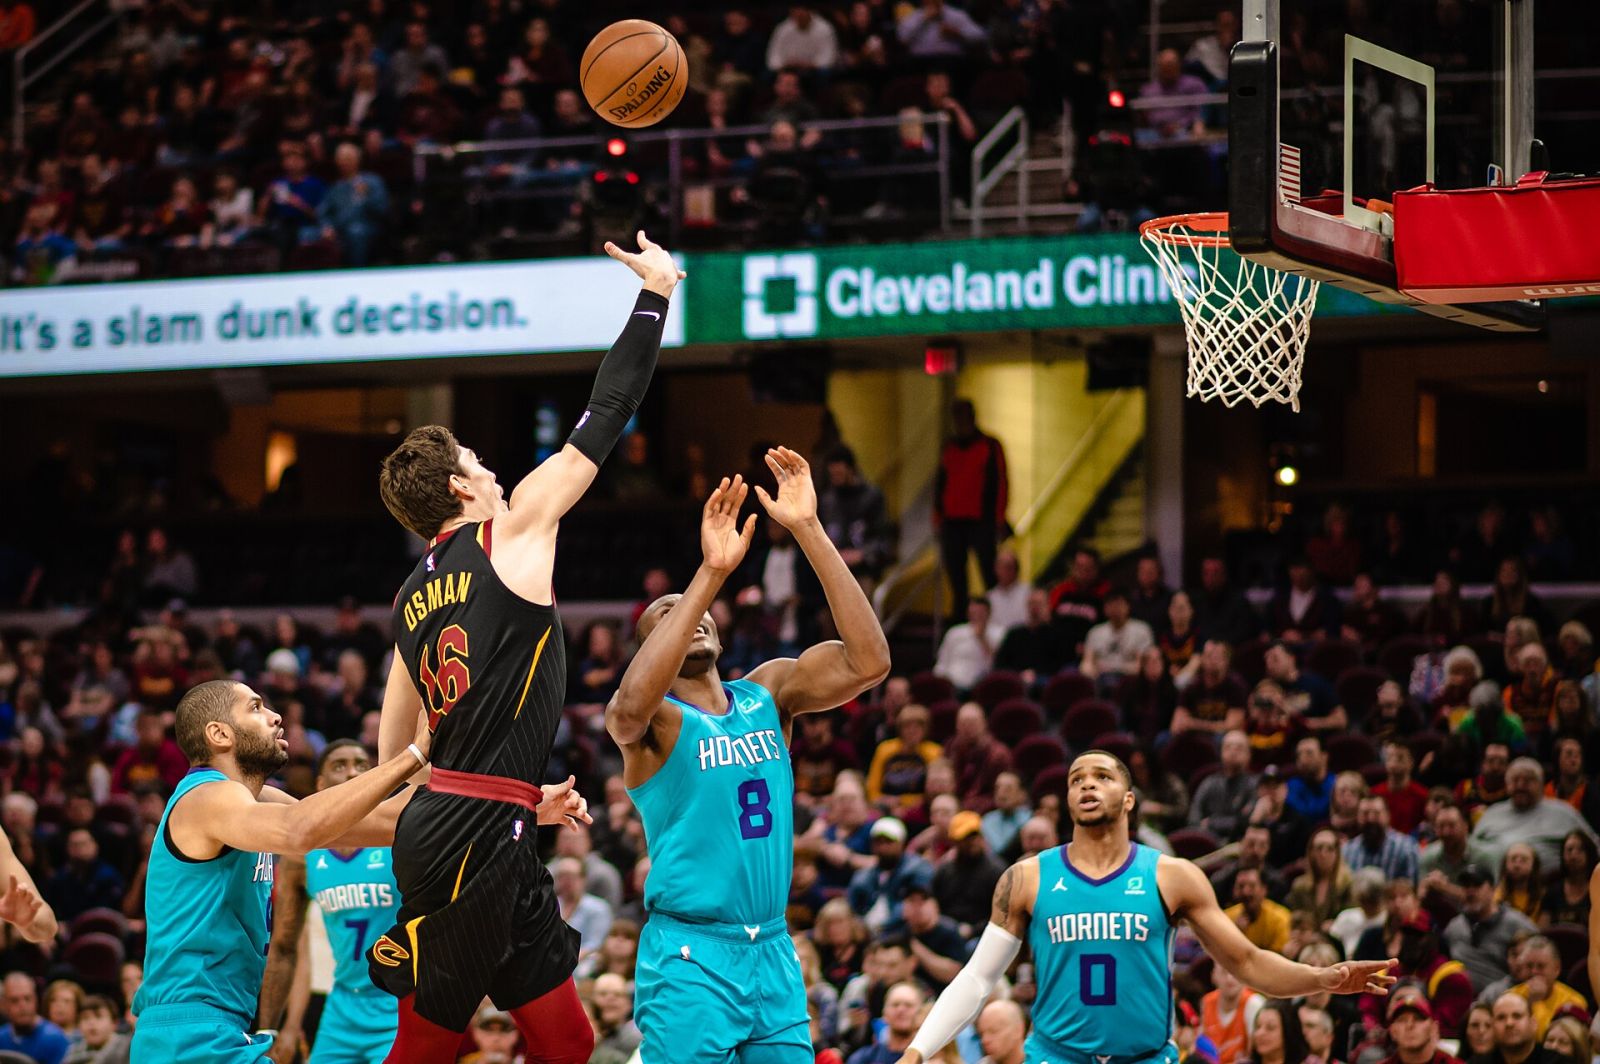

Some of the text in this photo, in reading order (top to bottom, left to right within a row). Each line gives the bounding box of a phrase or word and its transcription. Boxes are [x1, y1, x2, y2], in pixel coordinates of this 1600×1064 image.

[608, 65, 672, 120] SPALDING
[826, 258, 1054, 317] Cleveland
[0, 290, 528, 350] It's a slam dunk decision.
[404, 571, 472, 632] OSMAN
[419, 623, 471, 733] 16
[697, 729, 780, 772] HONETS
[737, 778, 773, 840] 8
[316, 883, 393, 914] HORNETS
[344, 918, 370, 962] 7
[1047, 911, 1149, 944] HORNETS
[1079, 953, 1117, 1006] 0
